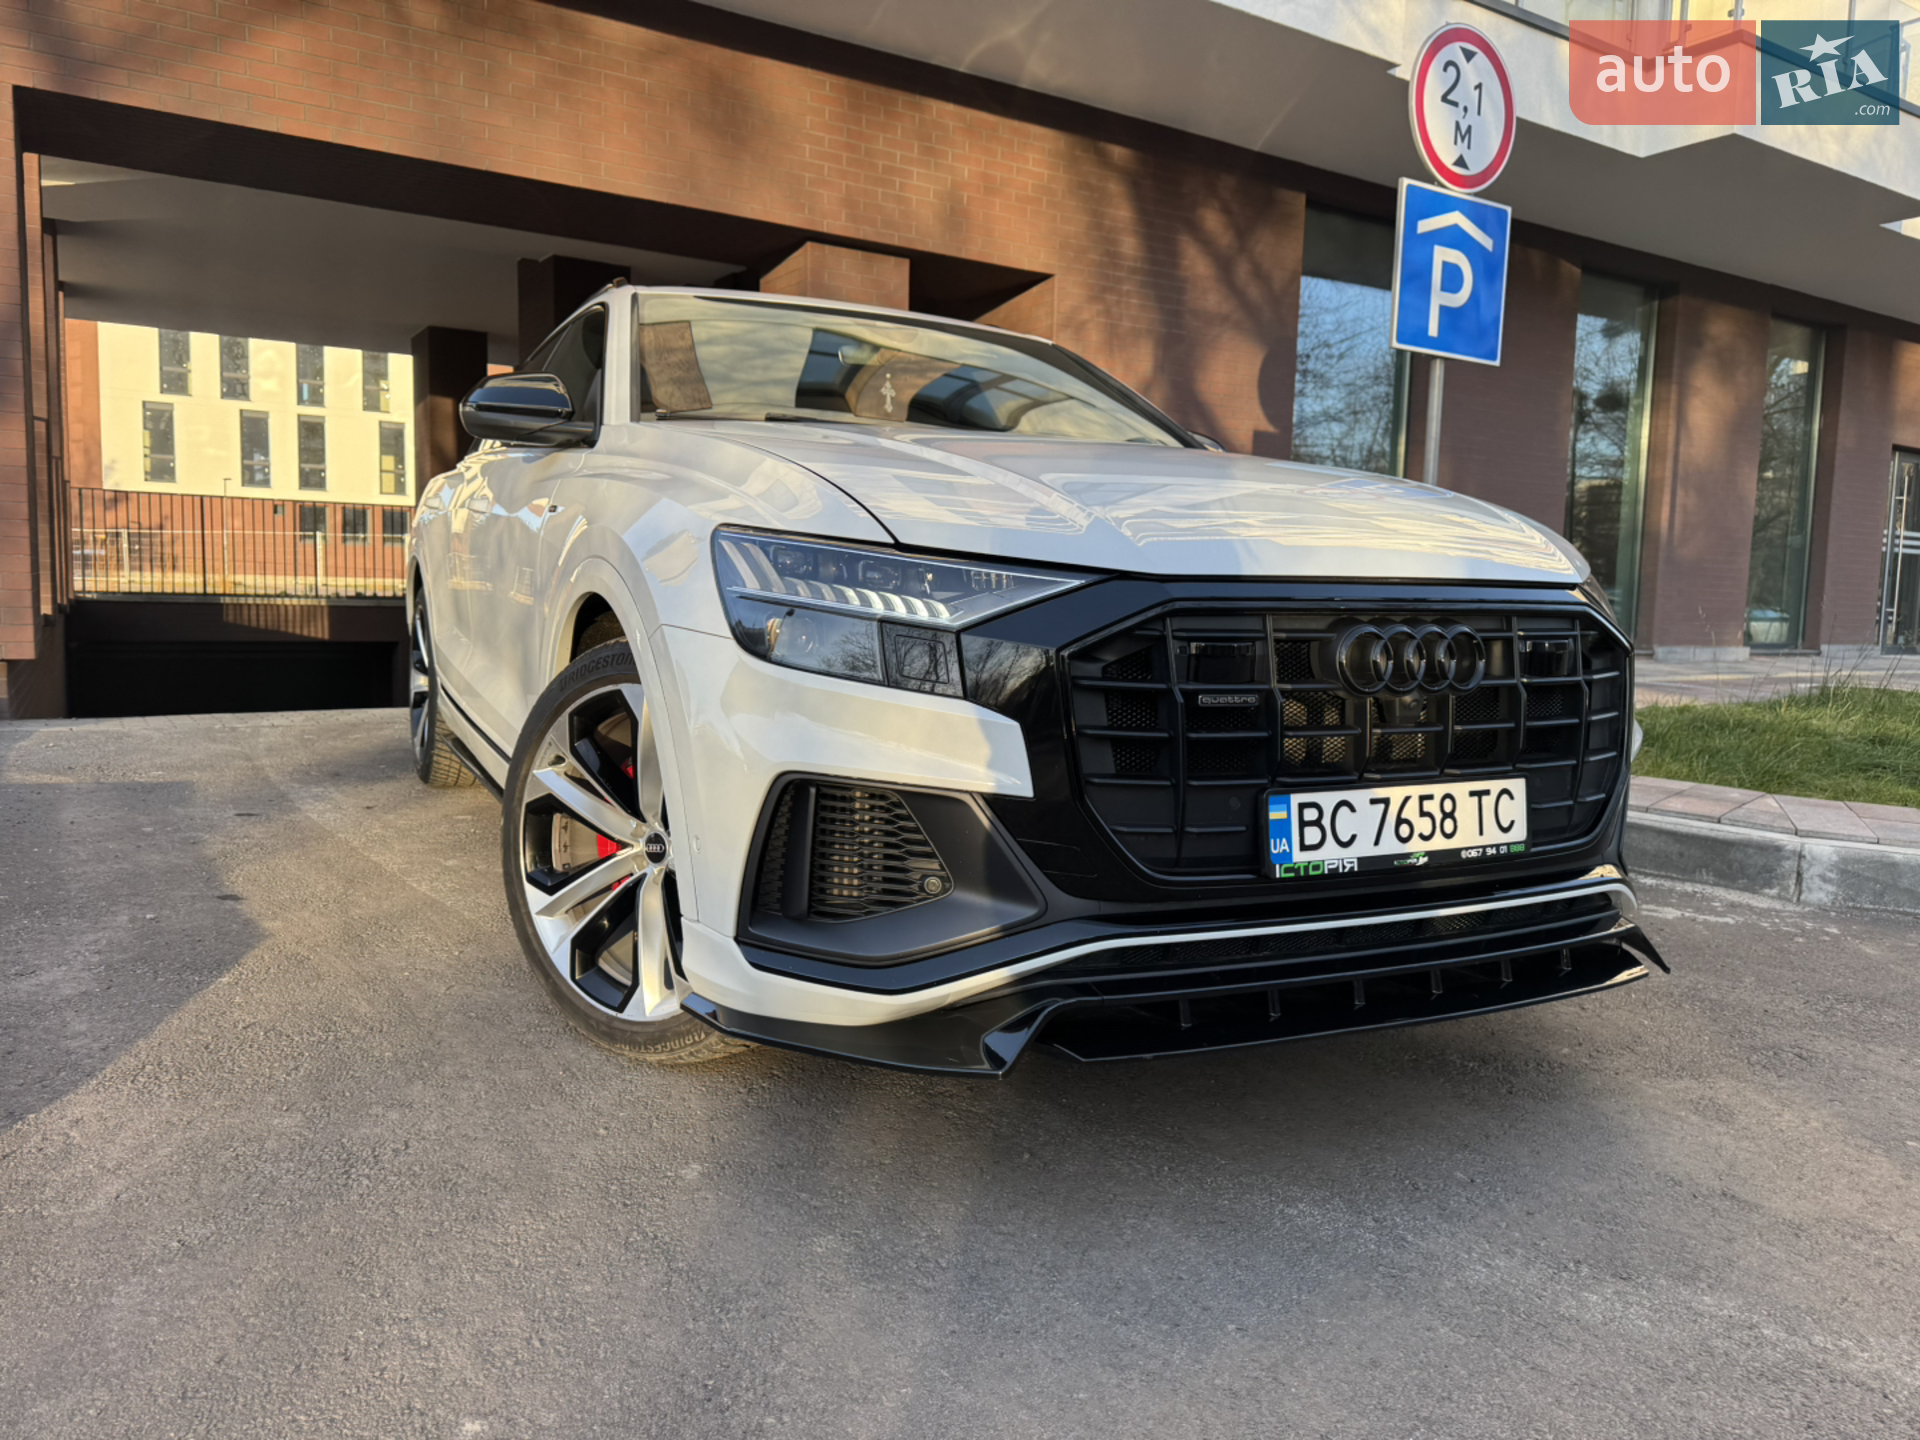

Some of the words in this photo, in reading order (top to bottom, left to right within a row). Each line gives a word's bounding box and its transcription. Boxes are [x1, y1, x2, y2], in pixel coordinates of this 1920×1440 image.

[1441, 59, 1483, 120] 2,1
[1428, 244, 1474, 338] P
[559, 652, 636, 692] BRIDGESTON
[1202, 696, 1256, 705] quattro
[1297, 799, 1358, 853] BC
[1368, 792, 1458, 847] 7658
[1468, 787, 1516, 837] TC
[1270, 837, 1290, 854] UA
